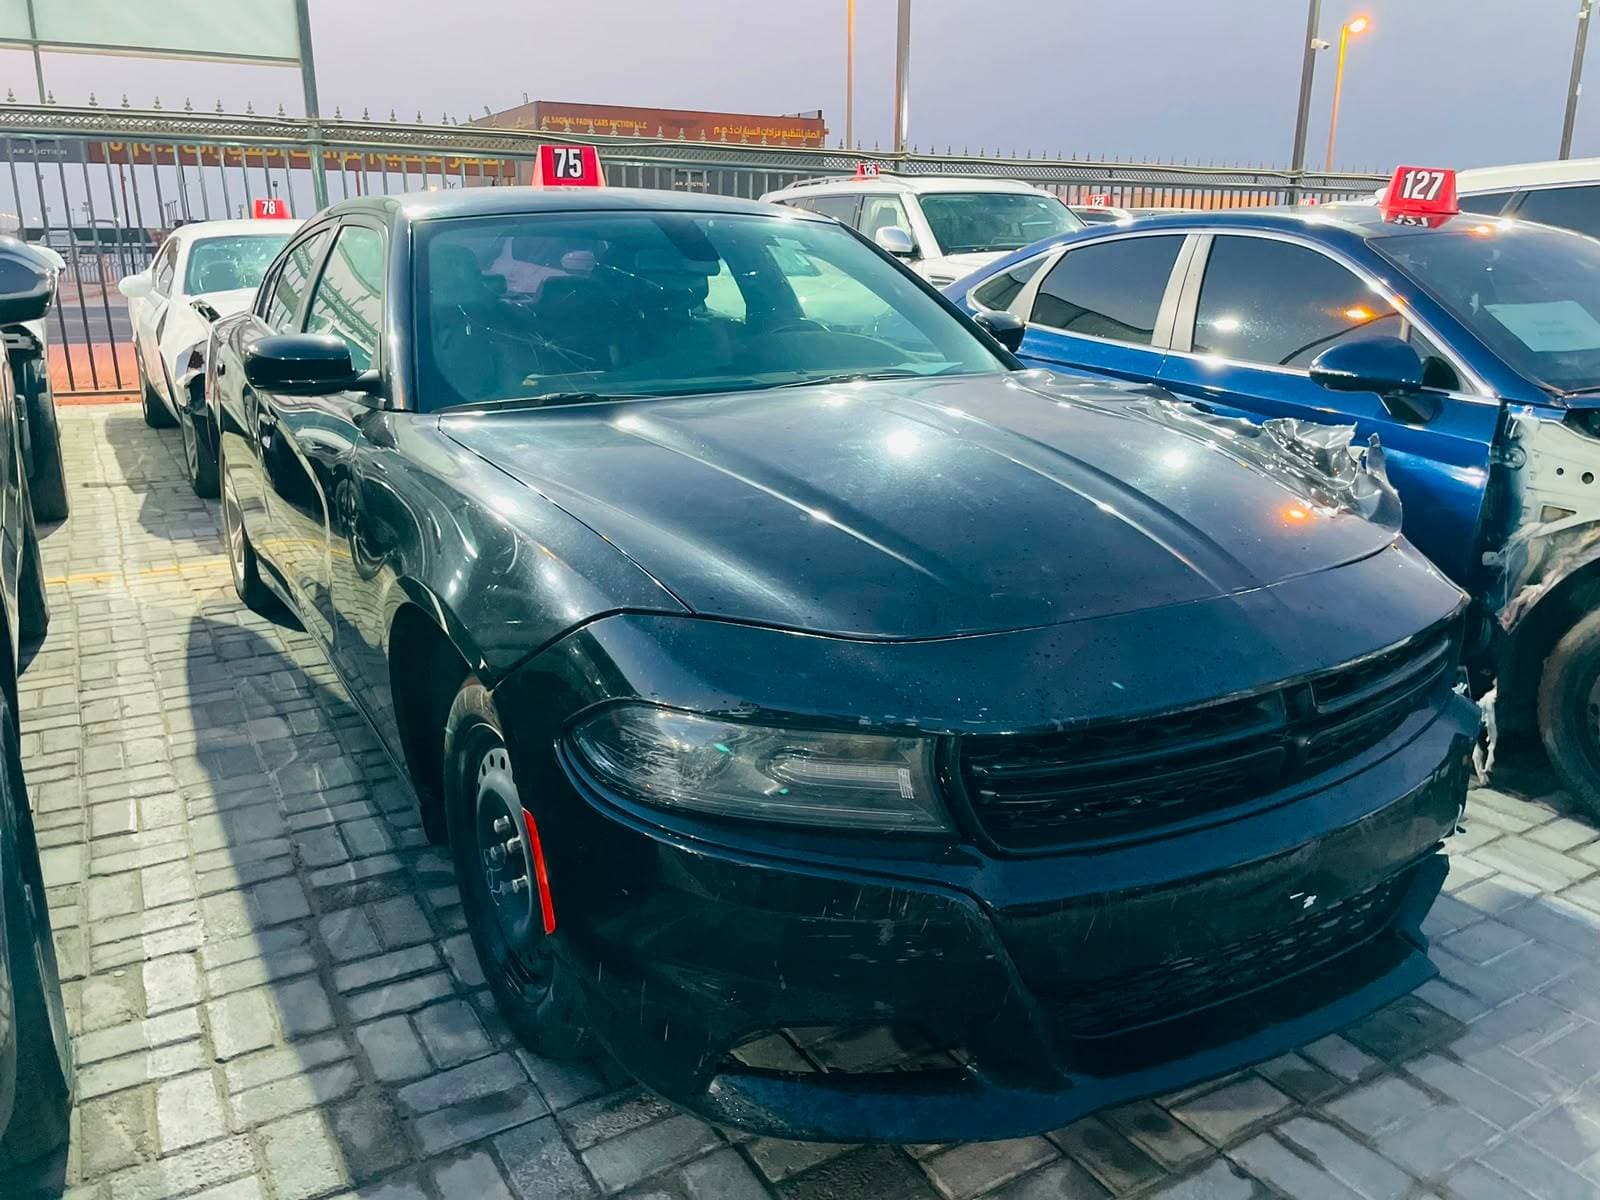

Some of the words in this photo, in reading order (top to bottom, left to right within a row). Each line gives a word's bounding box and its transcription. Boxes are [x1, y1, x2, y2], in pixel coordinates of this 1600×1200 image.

[554, 149, 582, 178] 75
[1402, 170, 1445, 201] 127
[261, 200, 276, 215] 78
